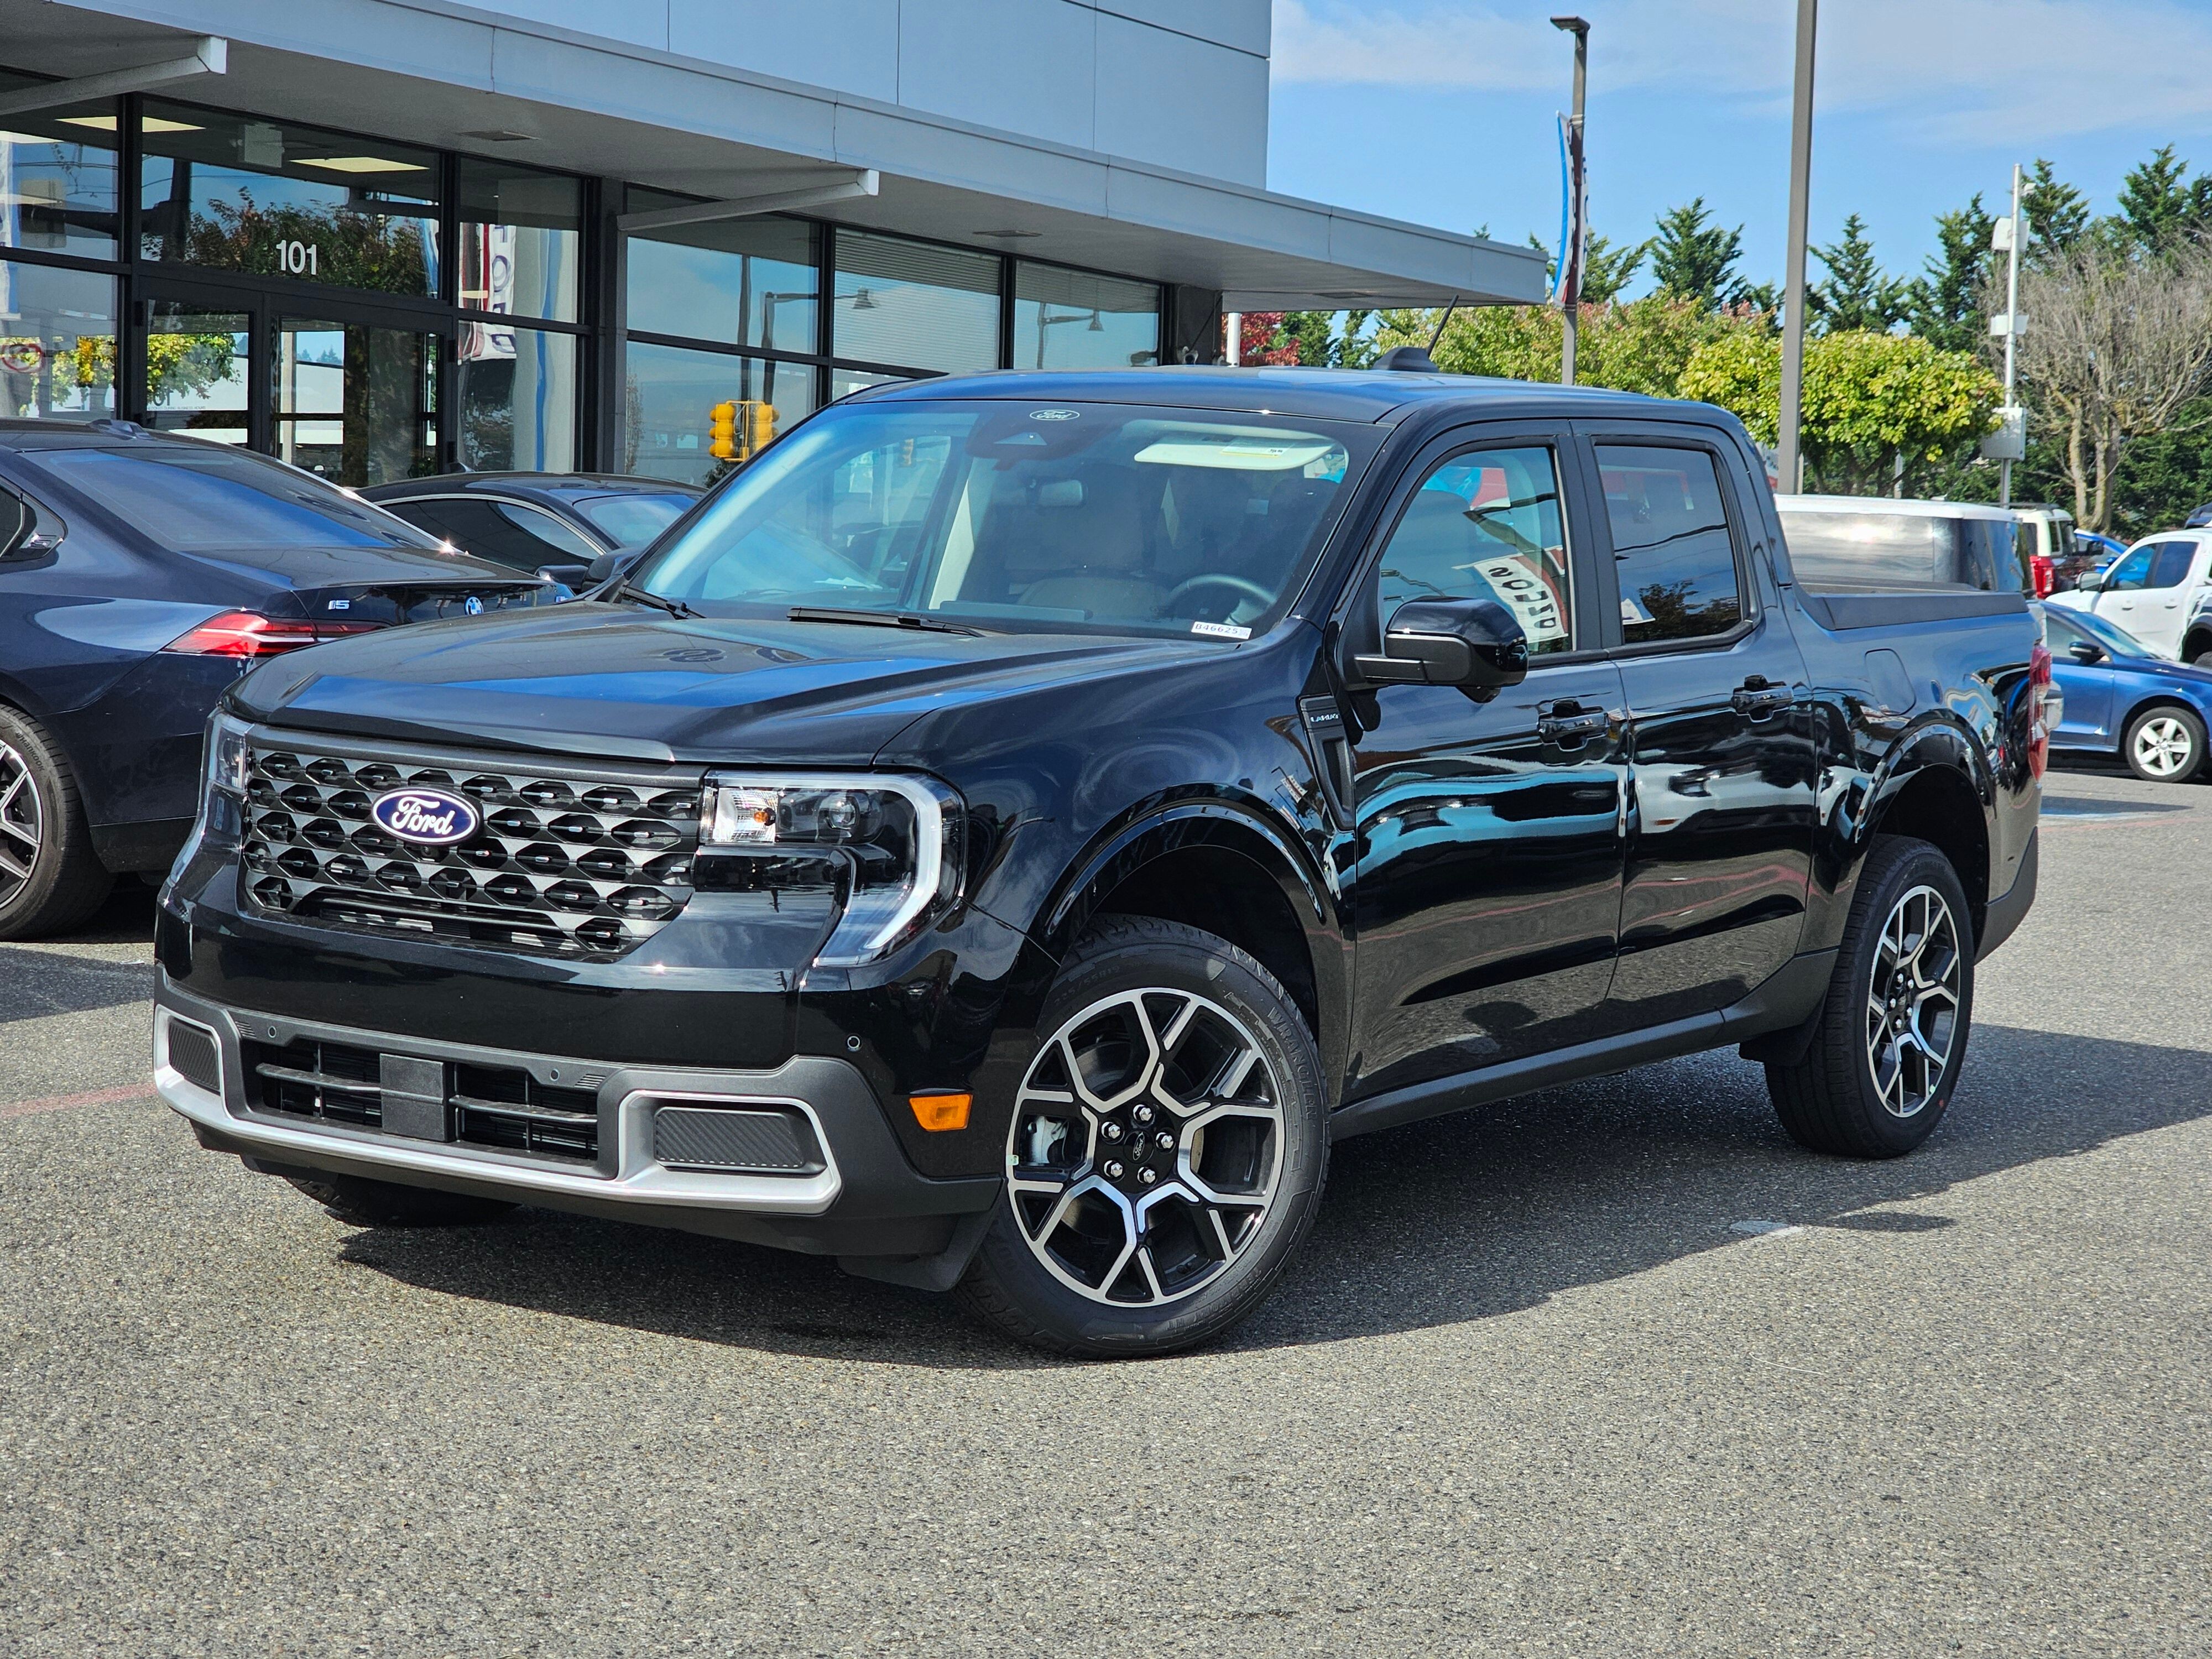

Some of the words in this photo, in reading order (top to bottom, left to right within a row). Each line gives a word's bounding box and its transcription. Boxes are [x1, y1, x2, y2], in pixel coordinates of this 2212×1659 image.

[275, 239, 317, 275] 101
[1036, 410, 1073, 419] Ford
[1195, 623, 1238, 634] B46625
[390, 796, 456, 835] Ford
[1267, 1006, 1317, 1120] WRANGLER
